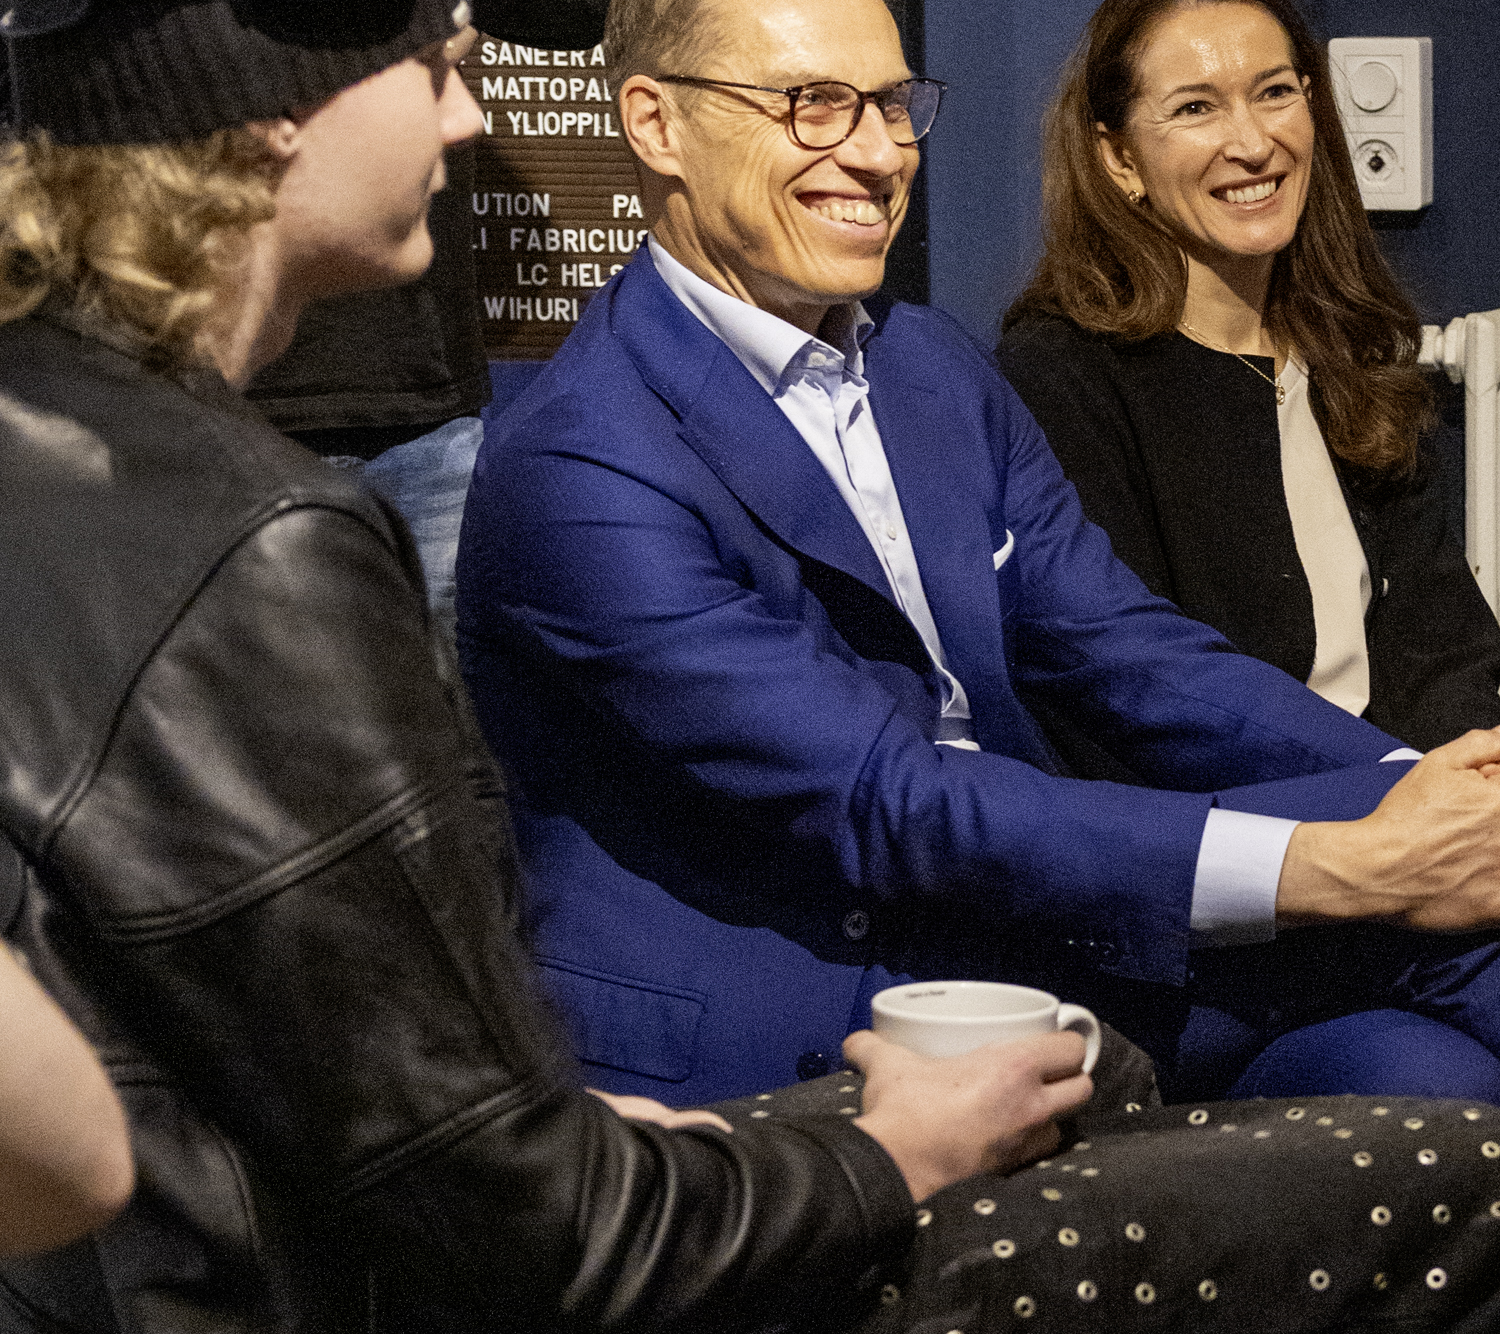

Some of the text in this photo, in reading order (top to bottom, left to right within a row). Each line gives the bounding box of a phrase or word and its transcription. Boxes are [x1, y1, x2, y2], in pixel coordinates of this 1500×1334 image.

[506, 110, 620, 138] YLIOPPIL
[472, 192, 644, 219] UTION PA
[517, 262, 549, 287] LC
[484, 296, 580, 323] WIHURI
